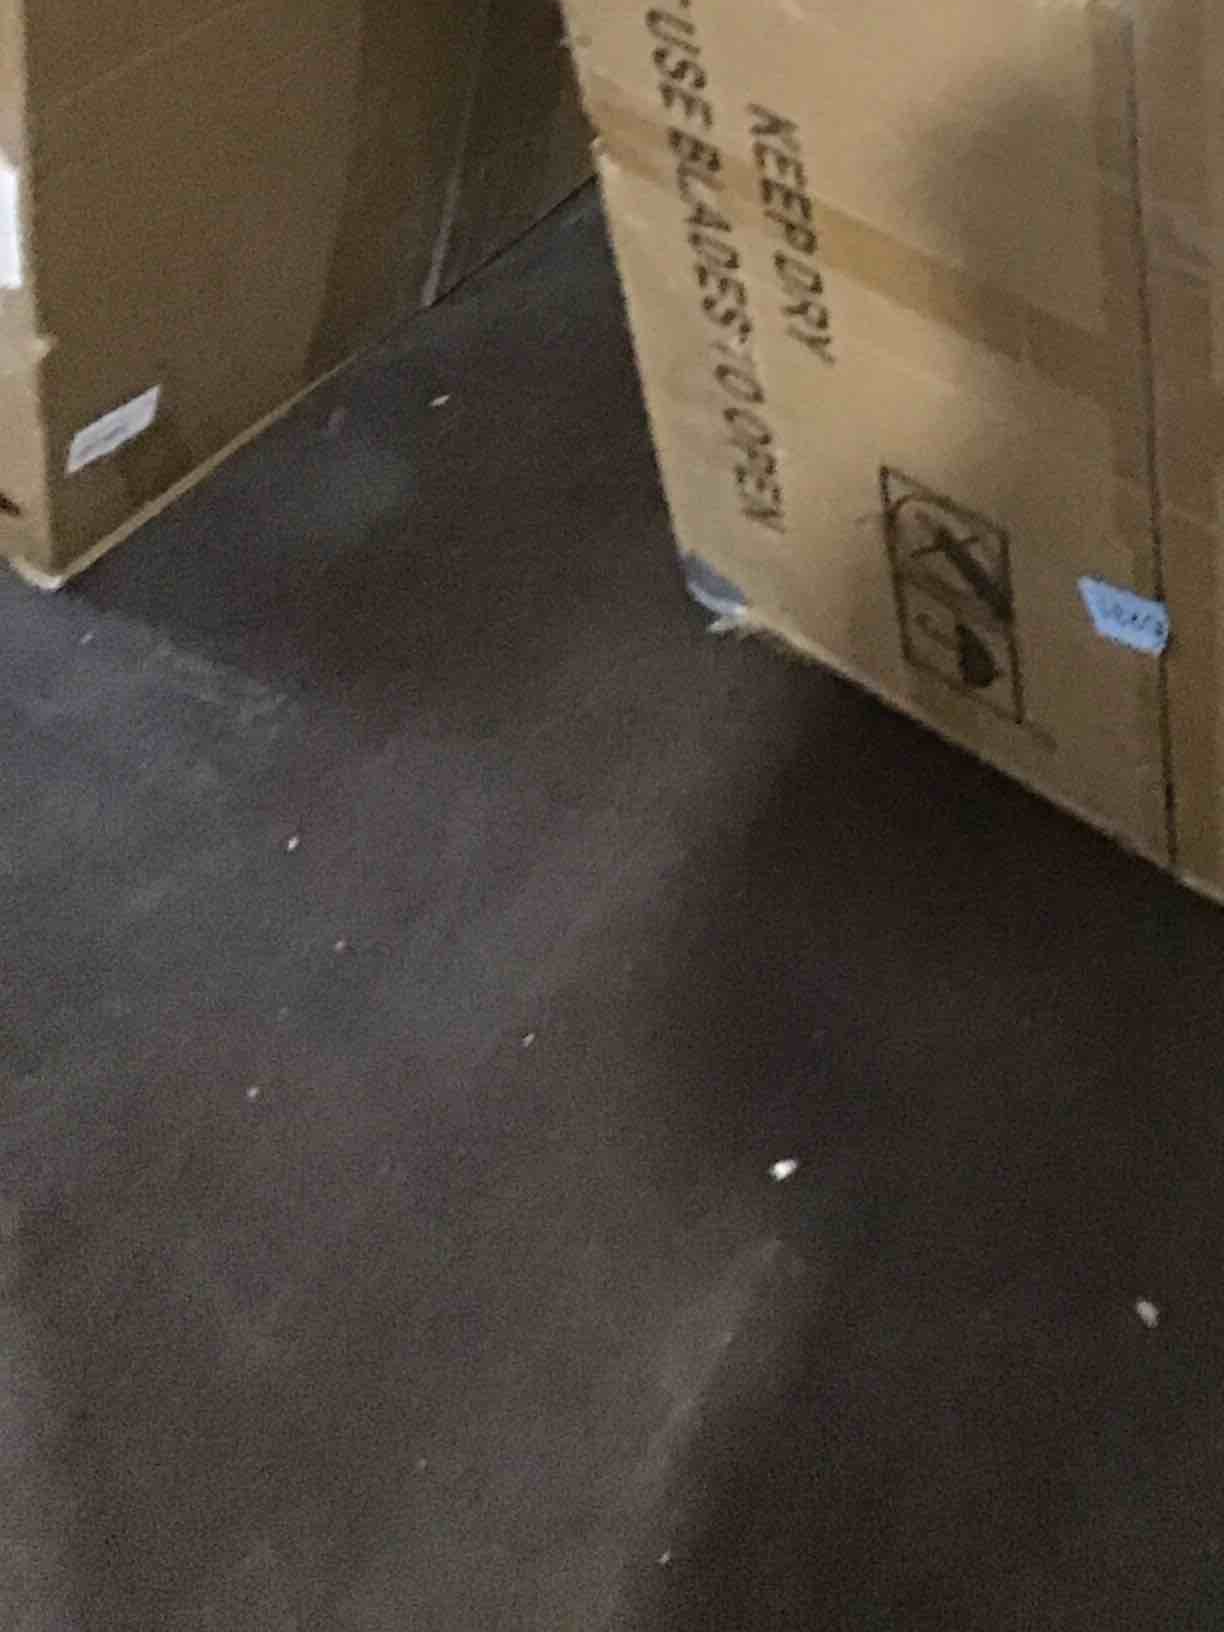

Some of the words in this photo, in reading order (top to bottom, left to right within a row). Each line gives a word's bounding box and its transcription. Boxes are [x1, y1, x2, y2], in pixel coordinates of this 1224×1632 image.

[645, 9, 713, 132] USE
[667, 125, 754, 344] BLADES
[748, 102, 819, 257] KEEP
[773, 249, 836, 367] DRY
[722, 405, 788, 536] OPEN
